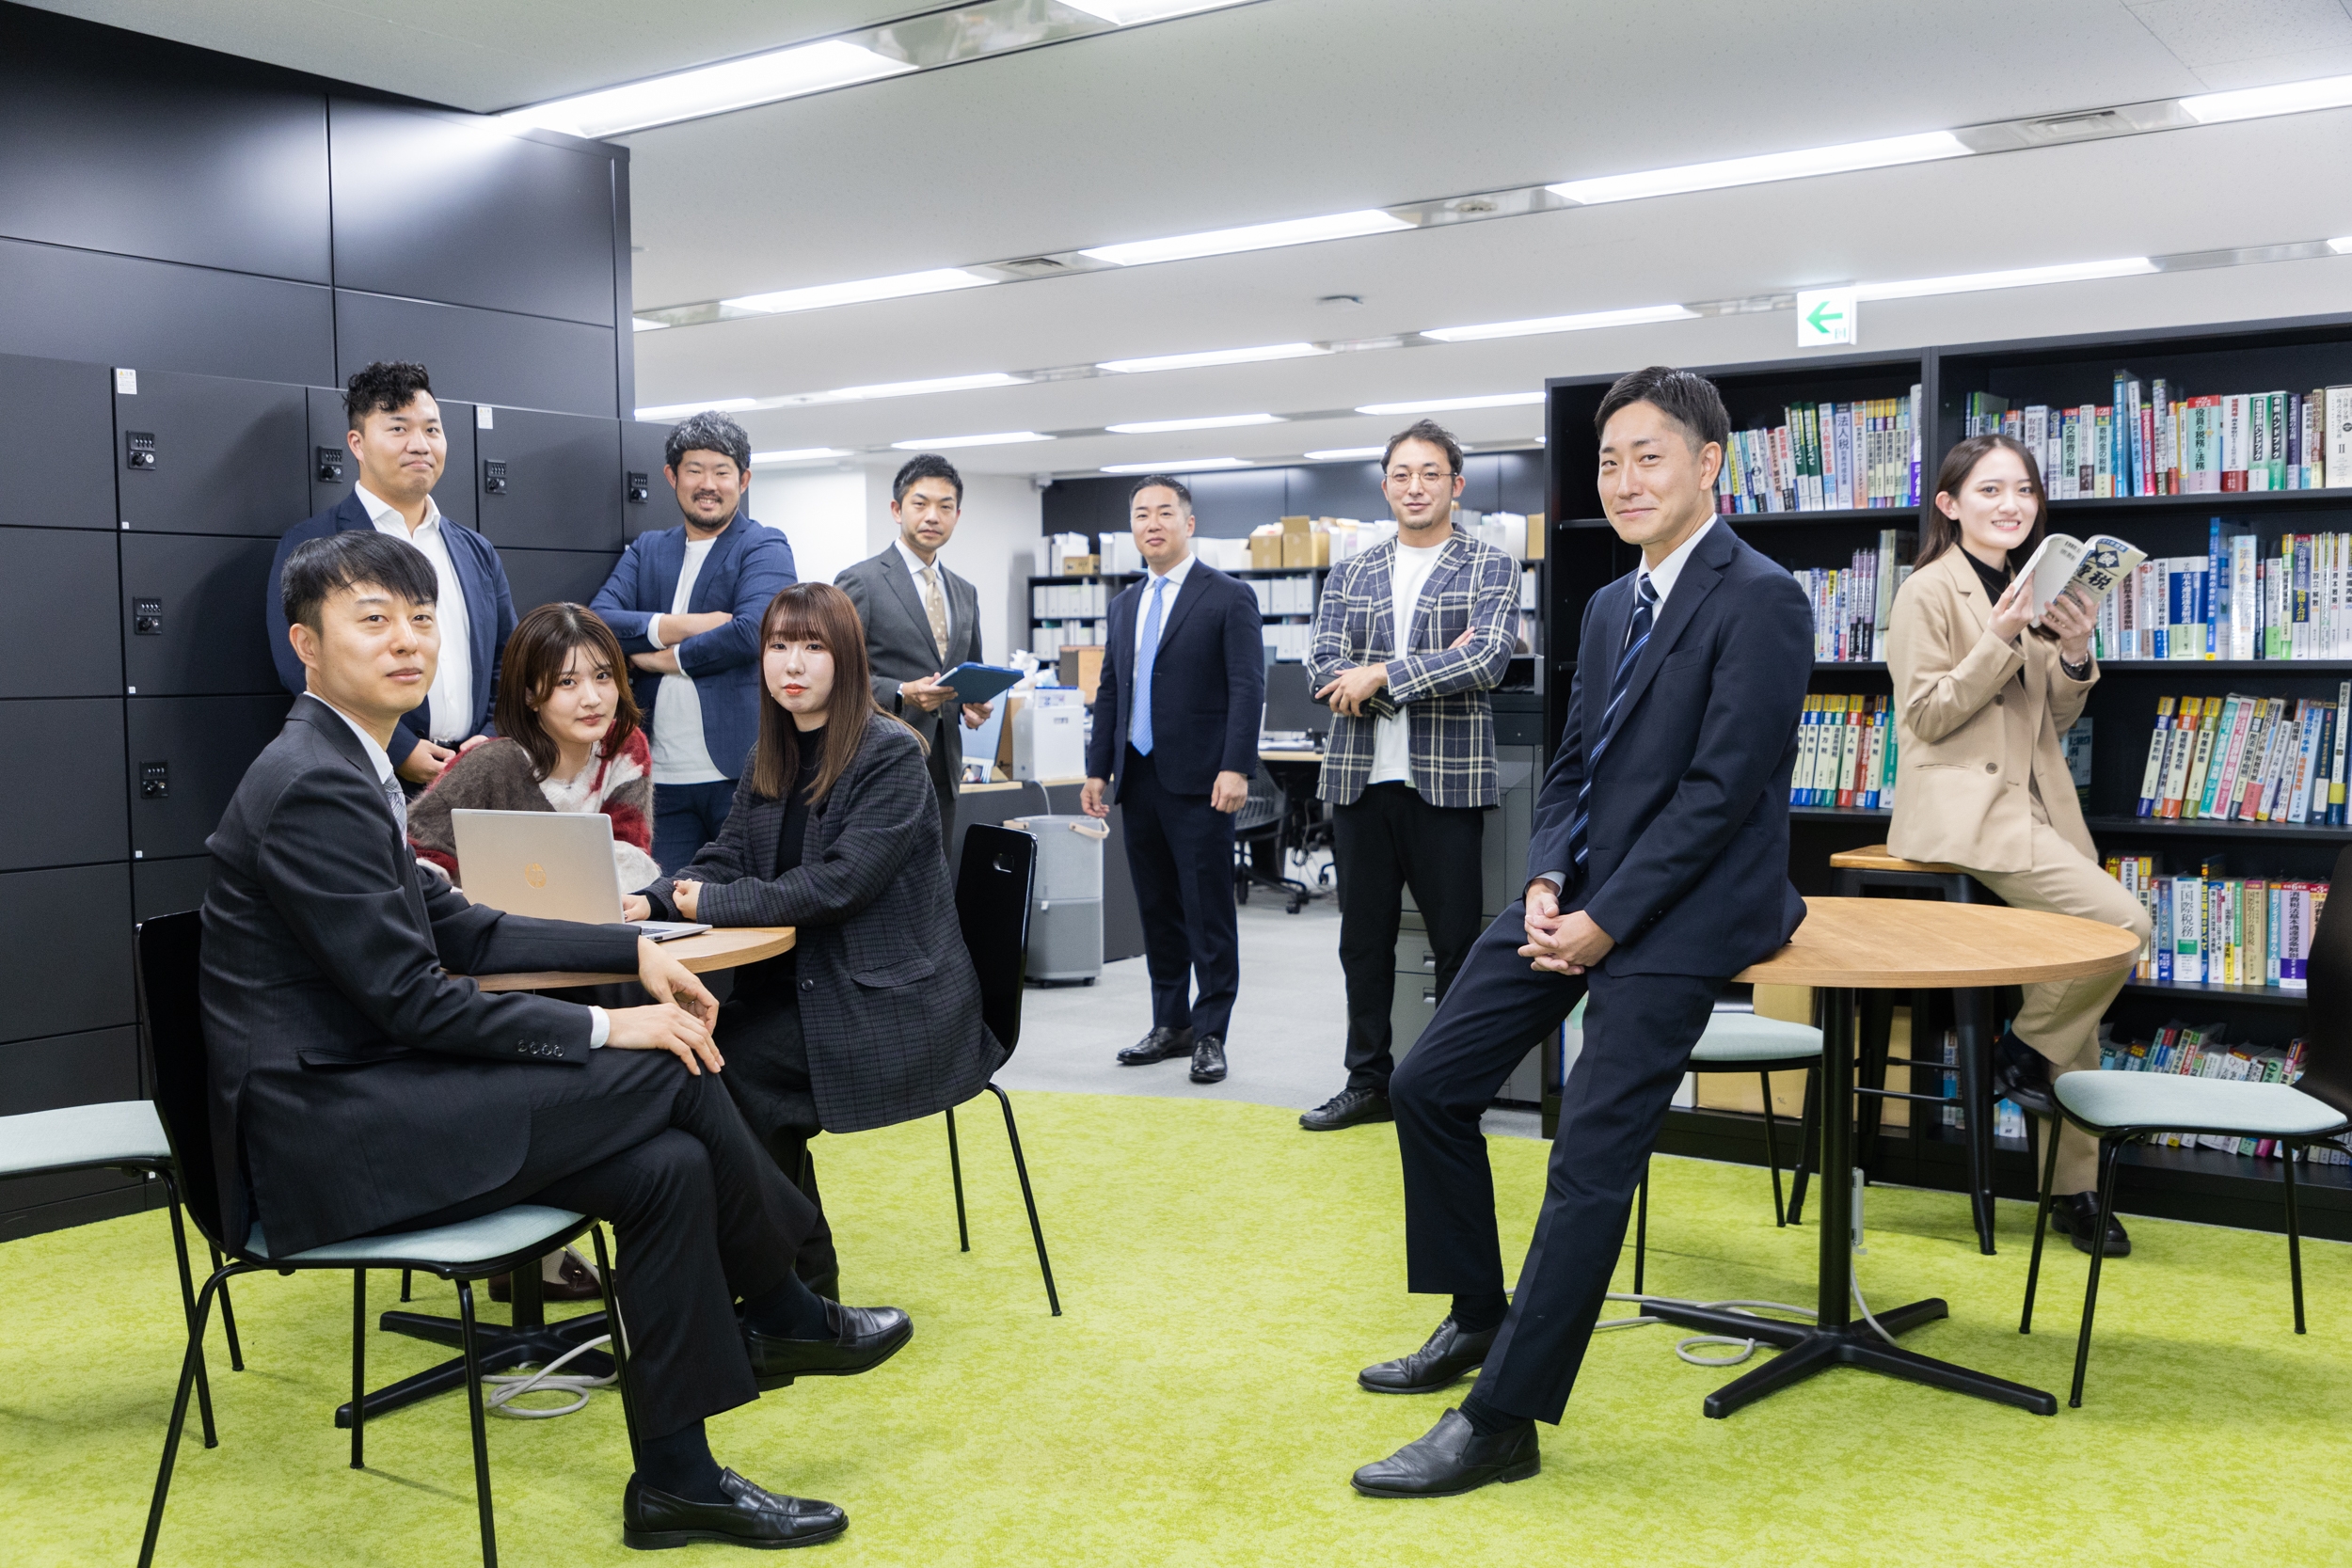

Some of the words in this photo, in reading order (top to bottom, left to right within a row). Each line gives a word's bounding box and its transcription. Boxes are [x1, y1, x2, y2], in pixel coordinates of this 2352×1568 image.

[1837, 416, 1850, 450] 法人税
[2195, 408, 2205, 470] 役員の税務と法務
[2273, 397, 2281, 459] 合併ハンドブック
[2066, 425, 2075, 478] 交際費の税務
[2098, 427, 2106, 474] 寄附金の税務
[1821, 726, 1830, 754] 地方税
[1847, 726, 1856, 754] 法人税
[1872, 727, 1882, 756] 所得税
[2197, 732, 2210, 764] 財産評価
[2180, 890, 2194, 938] 国際税務
